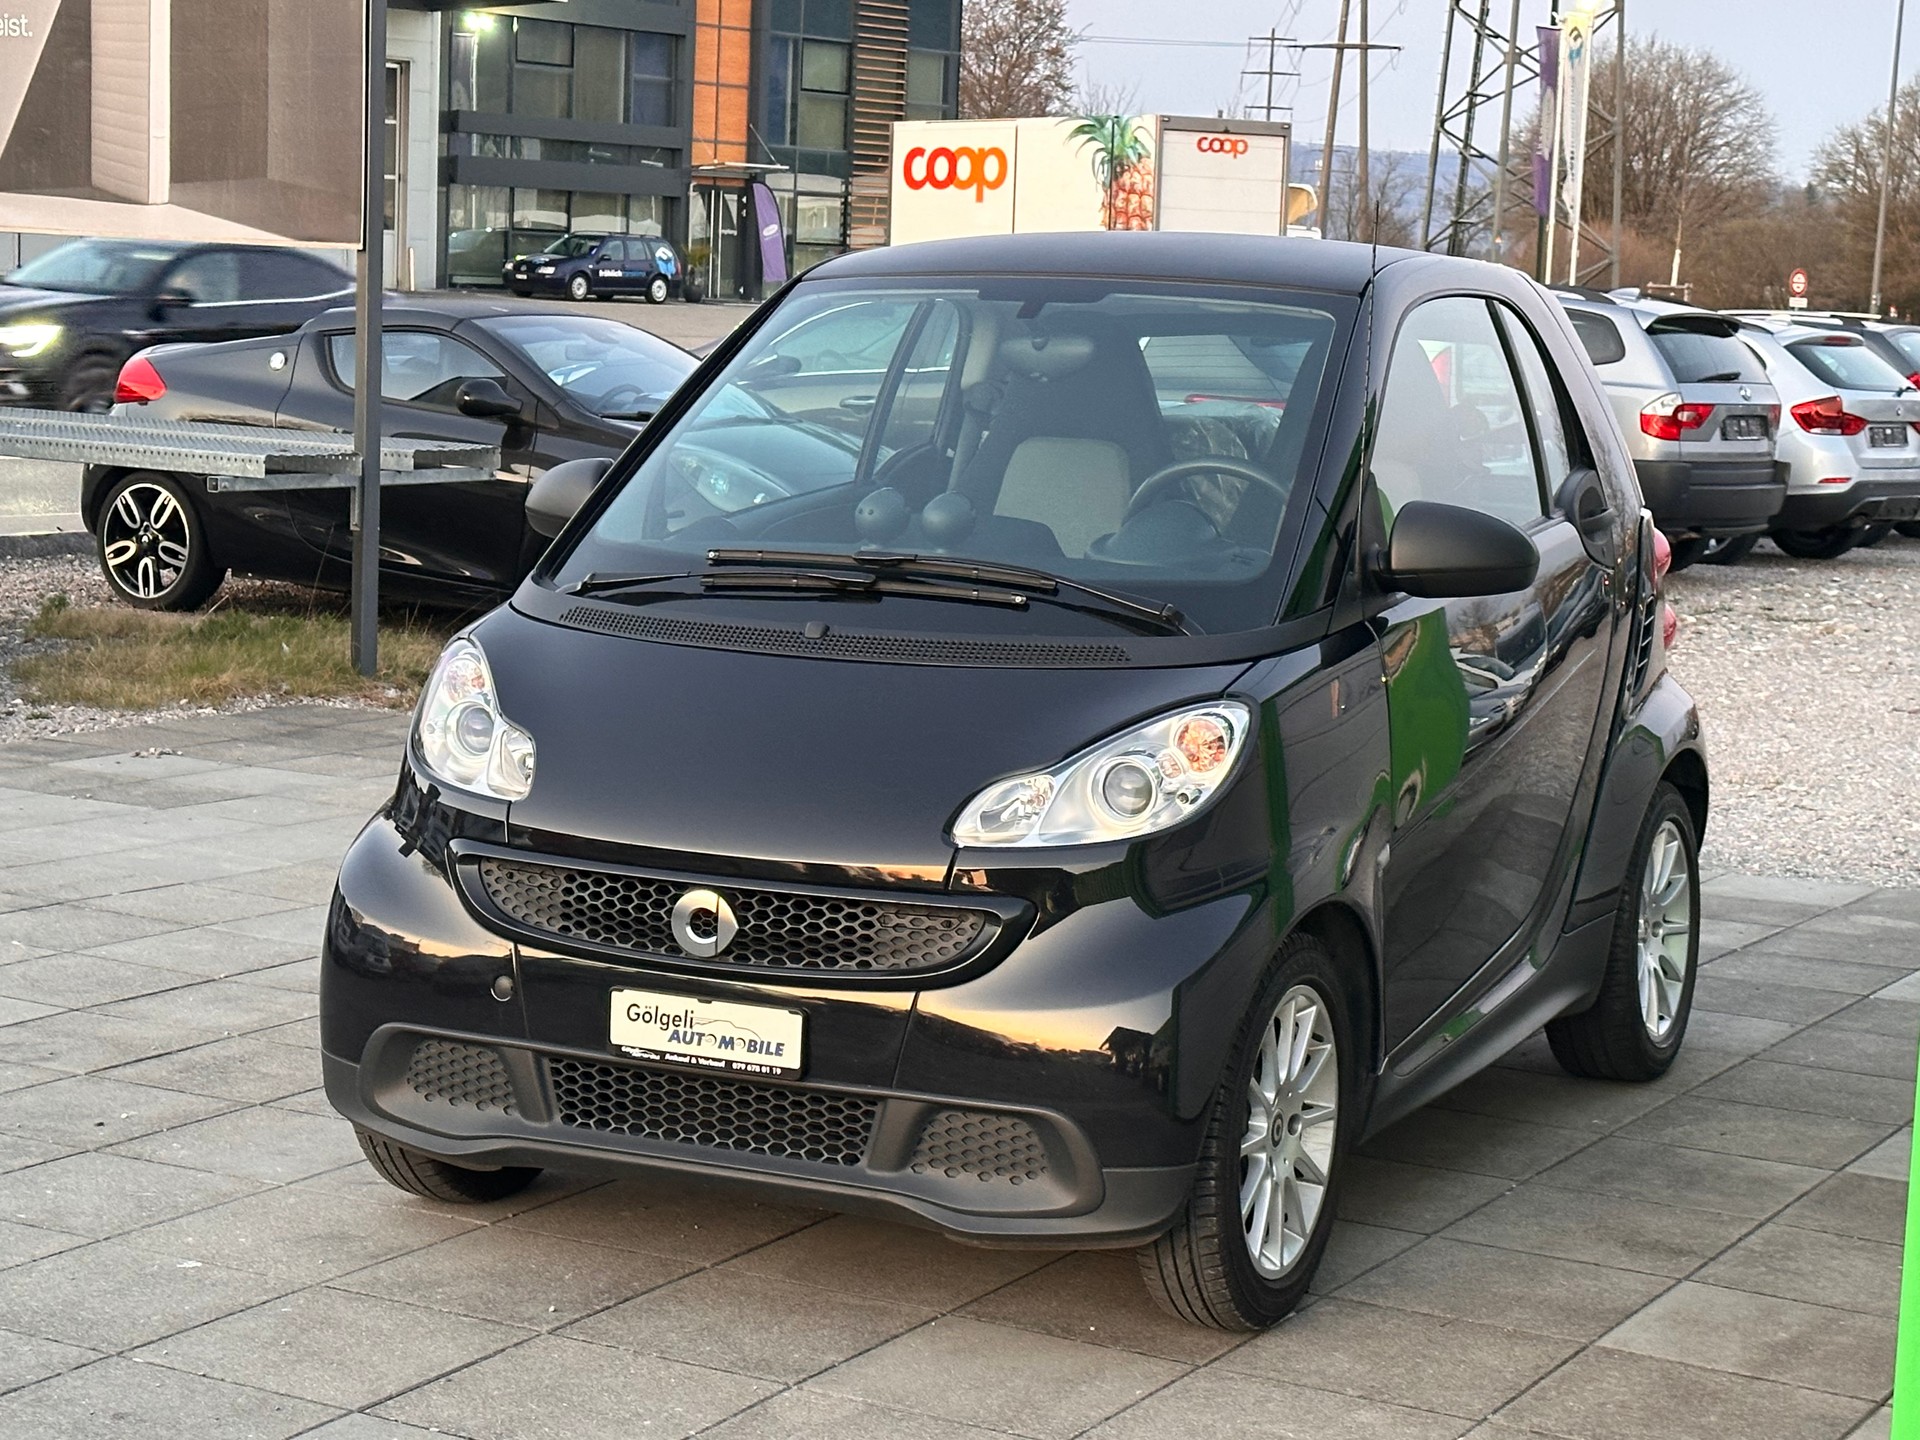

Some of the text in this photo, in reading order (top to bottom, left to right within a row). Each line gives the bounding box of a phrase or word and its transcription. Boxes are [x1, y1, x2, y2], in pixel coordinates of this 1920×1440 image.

[1197, 136, 1248, 159] coop
[903, 146, 1008, 203] coop
[626, 1003, 695, 1031] Gölgeli
